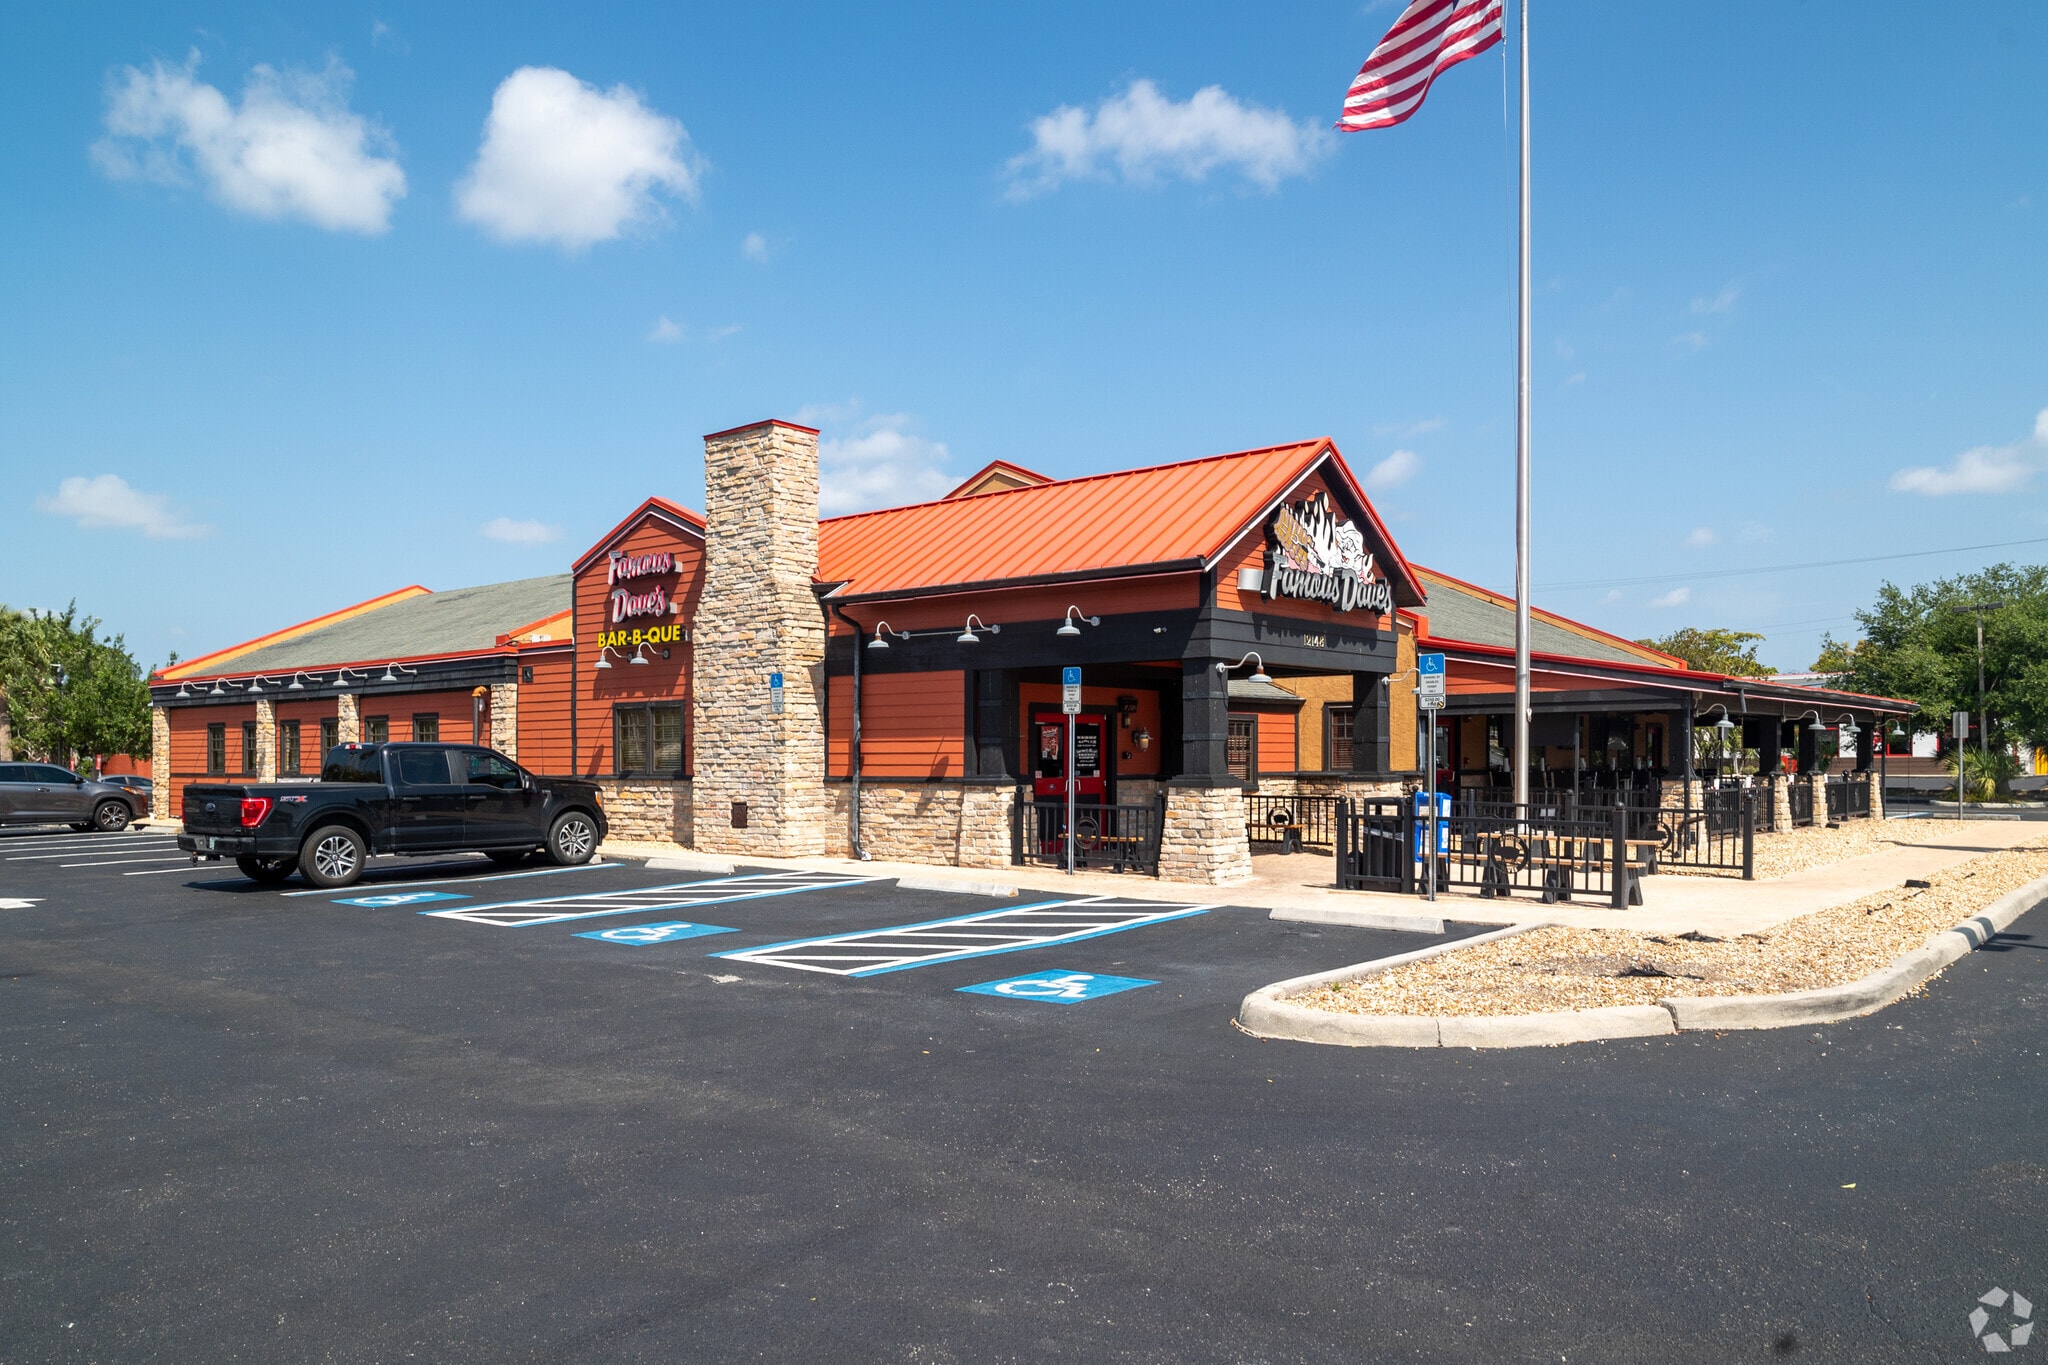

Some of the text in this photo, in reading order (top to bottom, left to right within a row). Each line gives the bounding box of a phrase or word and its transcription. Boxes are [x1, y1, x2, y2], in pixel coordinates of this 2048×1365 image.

[608, 550, 672, 585] Famous
[1269, 551, 1392, 615] Famous Dave's
[611, 585, 667, 623] Dave's
[597, 625, 681, 648] BAR-B-QUE
